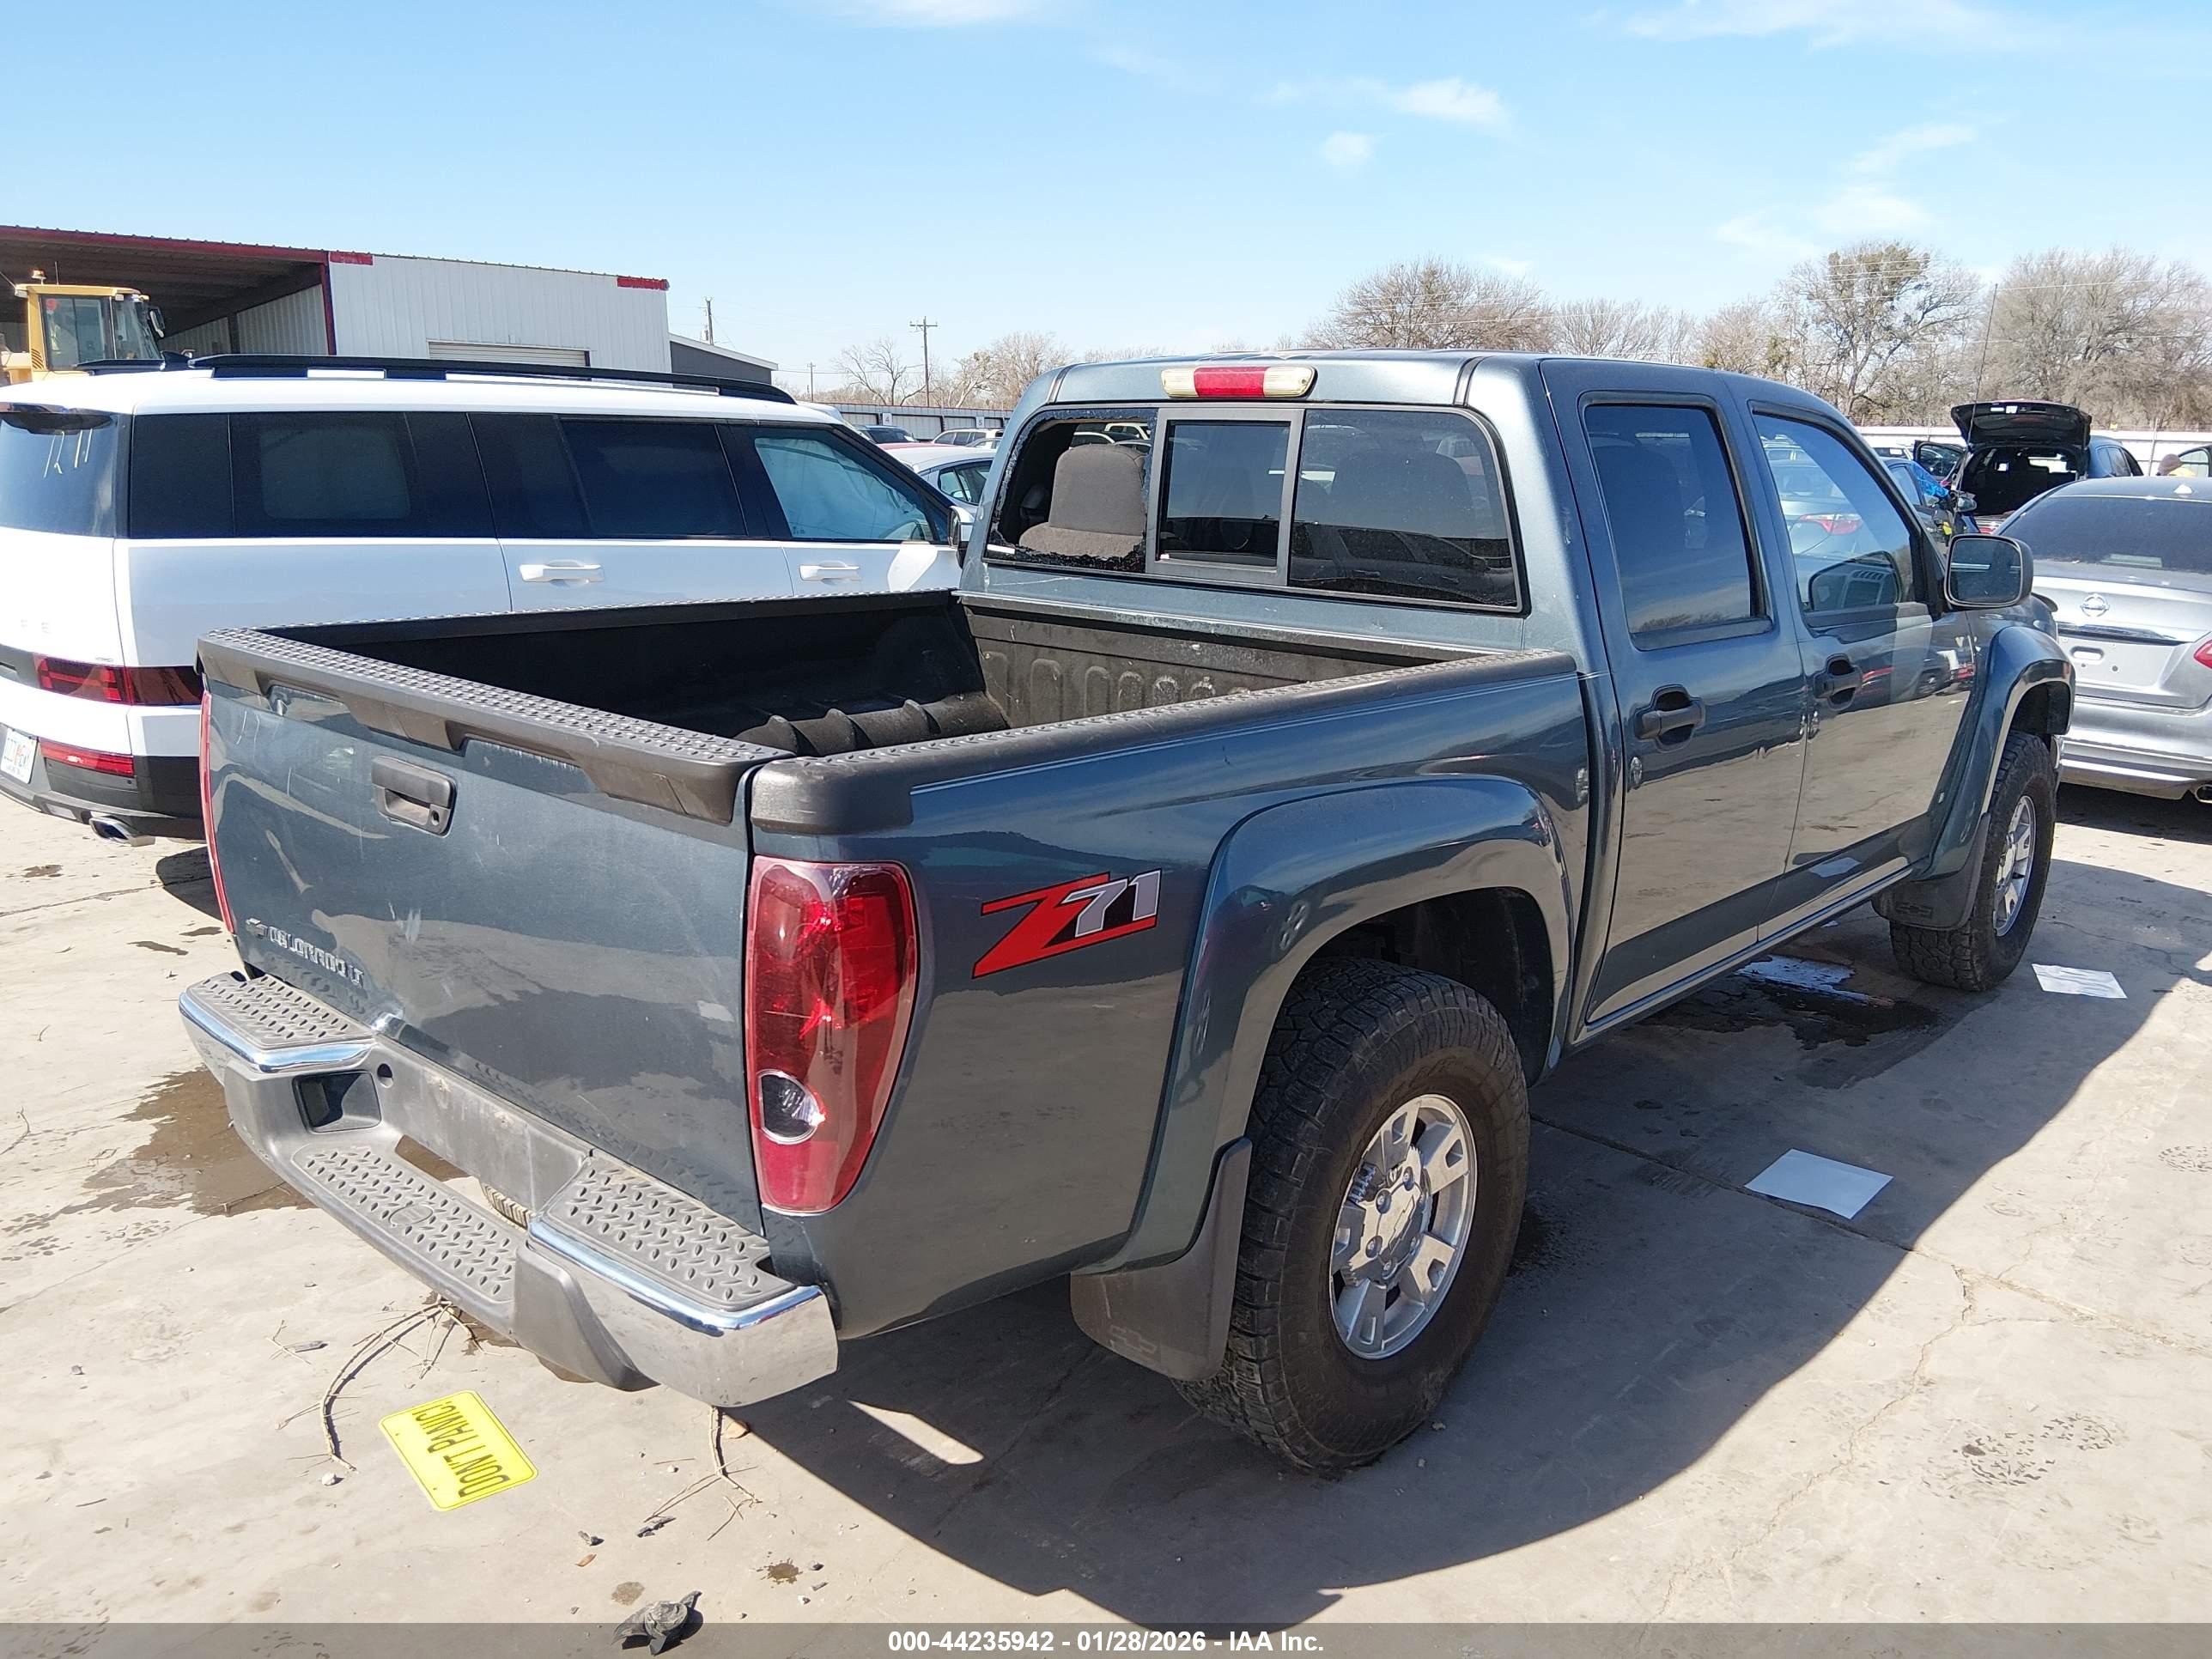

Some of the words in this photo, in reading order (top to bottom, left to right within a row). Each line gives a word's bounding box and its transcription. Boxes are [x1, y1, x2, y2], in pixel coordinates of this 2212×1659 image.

[971, 868, 1162, 980] Z71
[411, 1401, 479, 1454] PANIC!
[442, 1444, 511, 1498] DON'T
